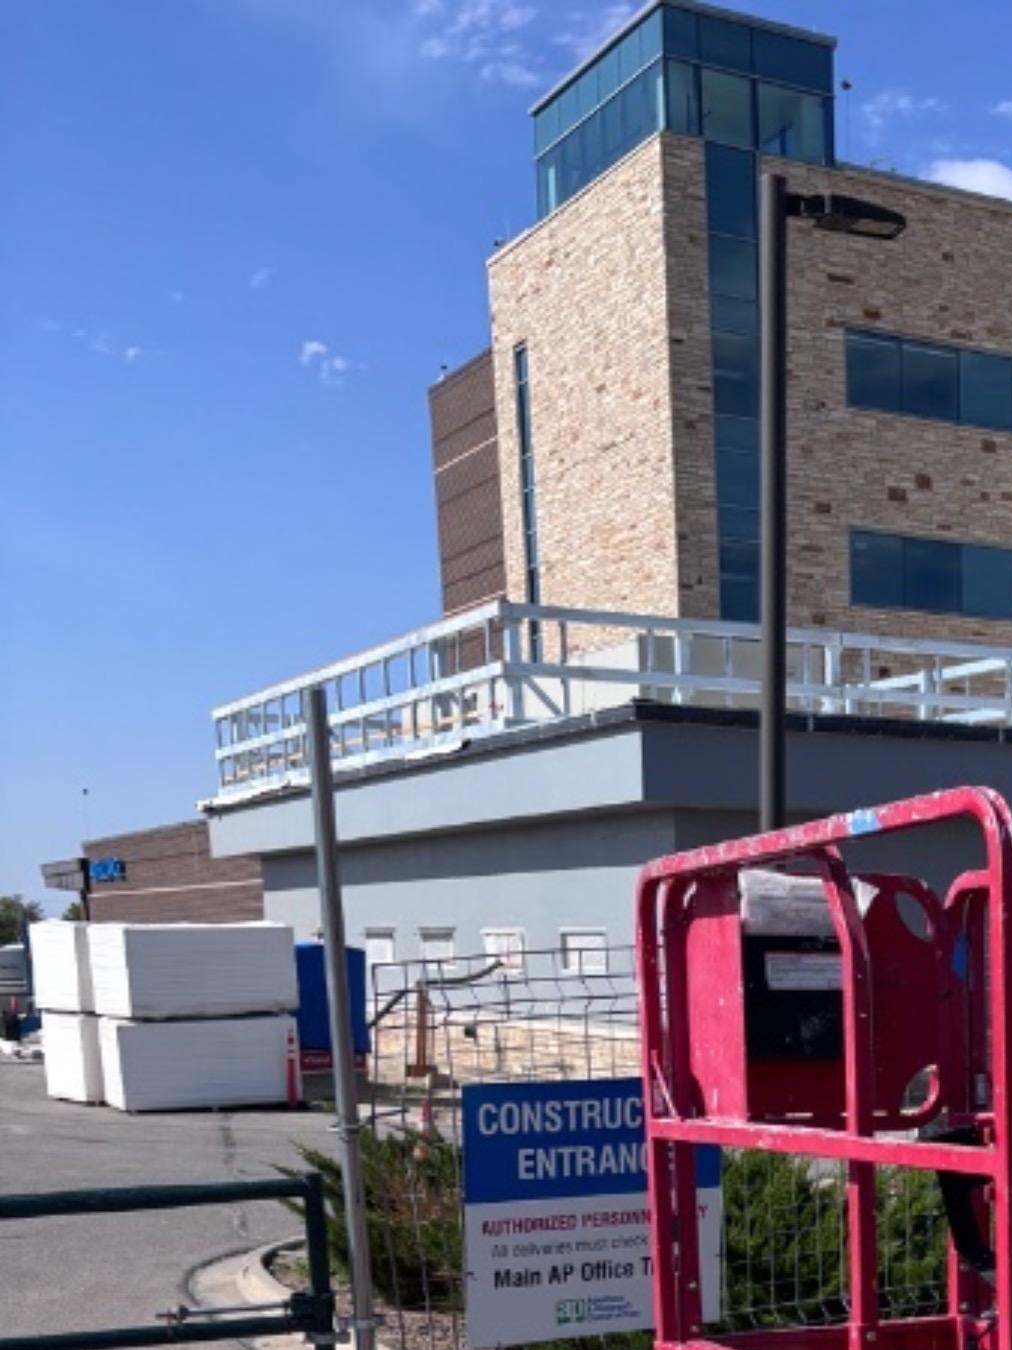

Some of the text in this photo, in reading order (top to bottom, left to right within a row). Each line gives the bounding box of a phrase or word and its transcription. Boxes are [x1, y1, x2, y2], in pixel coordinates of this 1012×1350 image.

[478, 1097, 643, 1136] CONSTRUC
[481, 1208, 651, 1237] AUTHORIZED PERSONN
[493, 1267, 541, 1289] Main
[548, 1264, 575, 1285] AP
[581, 1259, 635, 1281] Office
